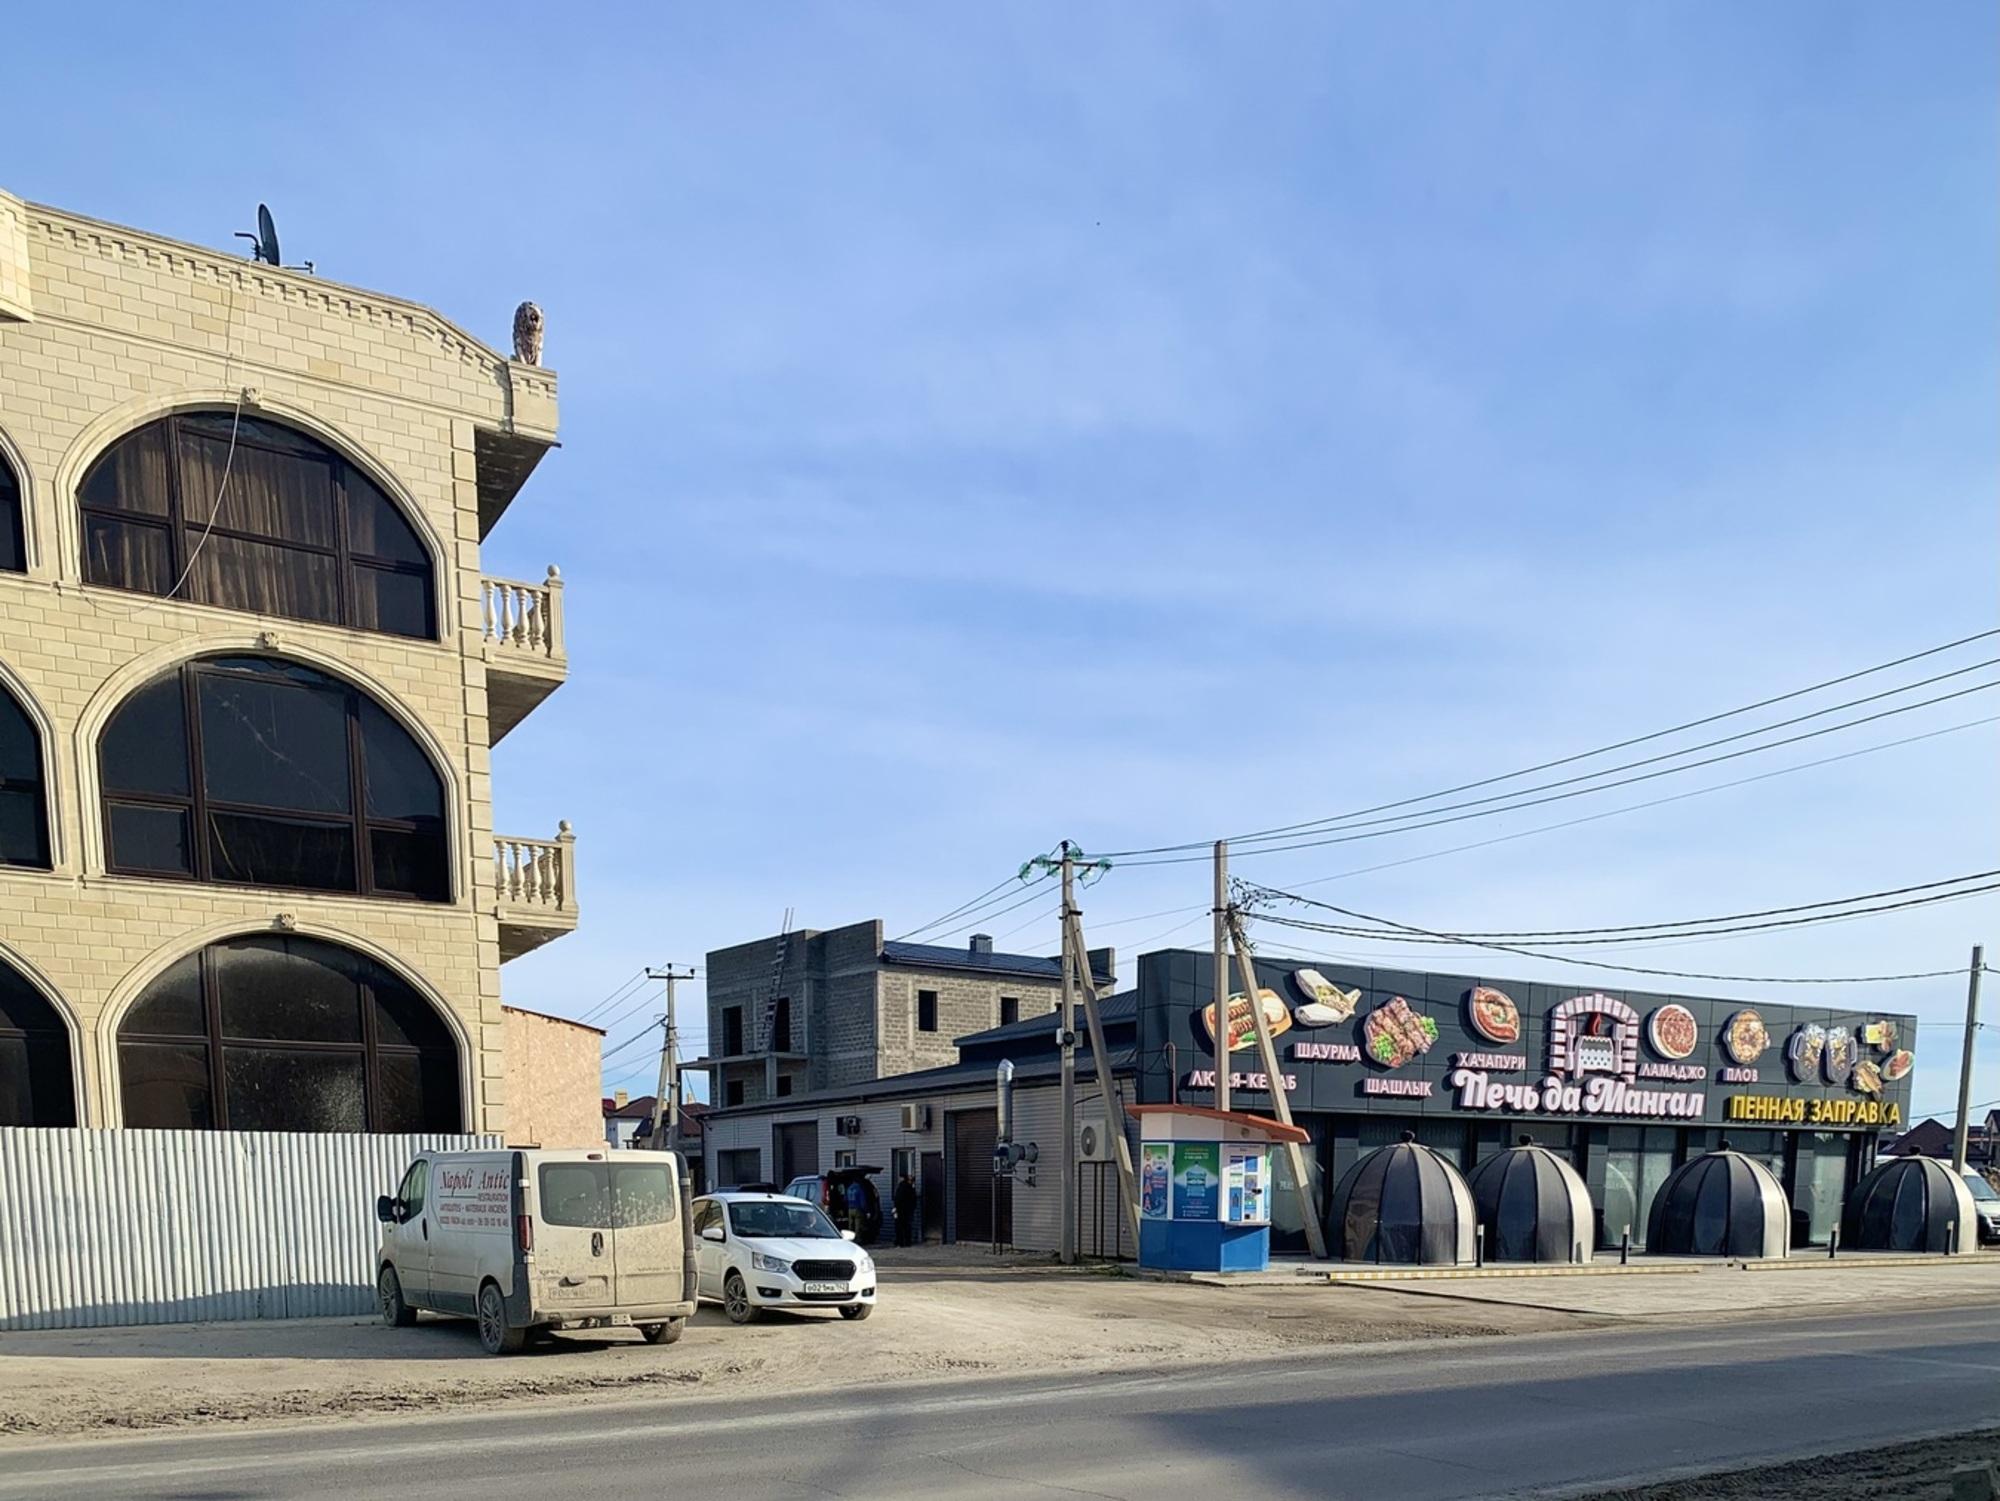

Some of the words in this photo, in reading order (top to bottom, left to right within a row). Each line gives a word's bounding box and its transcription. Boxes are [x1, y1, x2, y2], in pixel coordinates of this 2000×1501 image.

[1296, 1043, 1361, 1061] ШАУРМА
[1457, 1052, 1527, 1070] ХАЧАПУРИ
[1189, 1069, 1297, 1090] ЛЮЯ-КЕАБ
[1640, 1063, 1706, 1080] ЛАМАДЖО
[1725, 1067, 1758, 1082] ПЛОВ
[1365, 1078, 1432, 1096] ШАШЛЫК
[1452, 1069, 1540, 1111] Печь
[1543, 1076, 1581, 1112] да
[1583, 1077, 1705, 1117] Мангал
[1731, 1095, 1804, 1121] ПЕННАЯ
[1811, 1099, 1901, 1125] ЗАПРАВКА
[440, 1167, 474, 1197] Napoli
[478, 1168, 510, 1189] Antic
